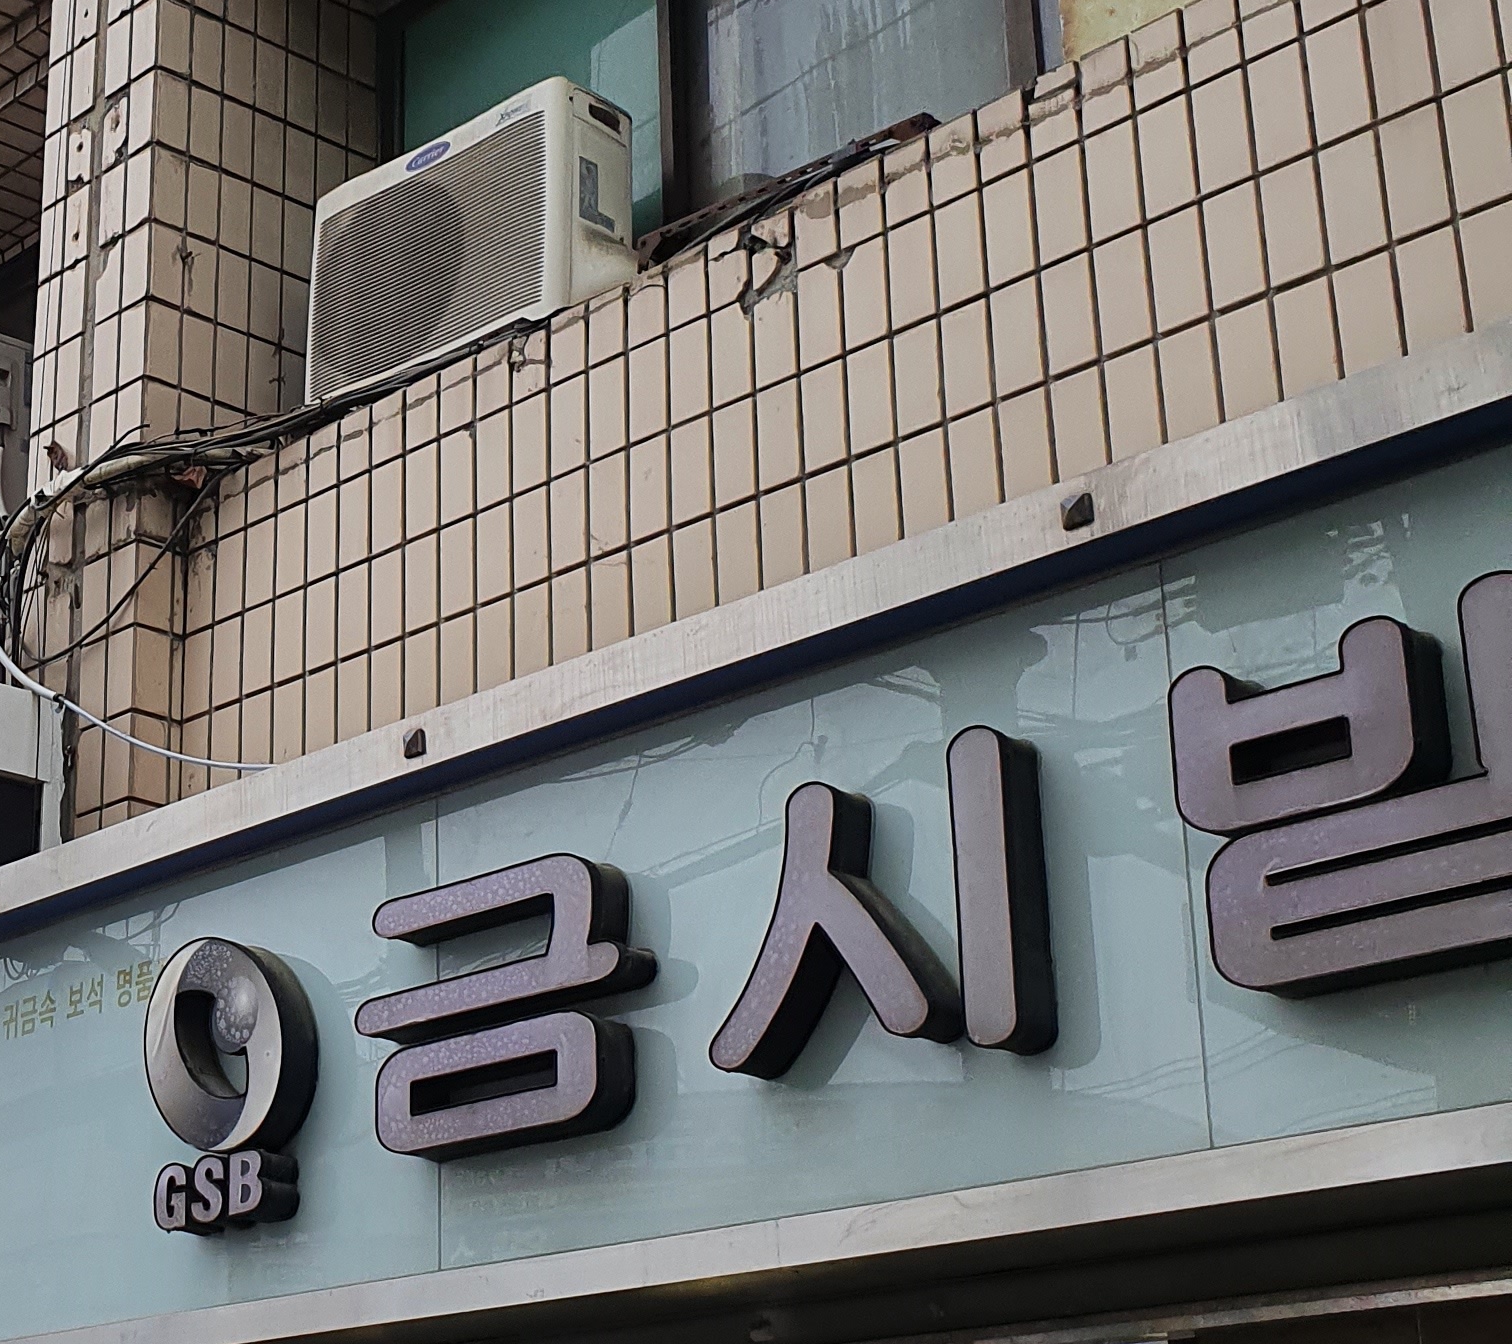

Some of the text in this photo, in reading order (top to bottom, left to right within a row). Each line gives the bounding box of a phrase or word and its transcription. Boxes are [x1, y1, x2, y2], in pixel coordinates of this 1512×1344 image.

[355, 570, 1512, 1160] 금시밭
[3, 959, 166, 1040] 귀금속 보석 명품
[154, 1150, 266, 1233] GSB
